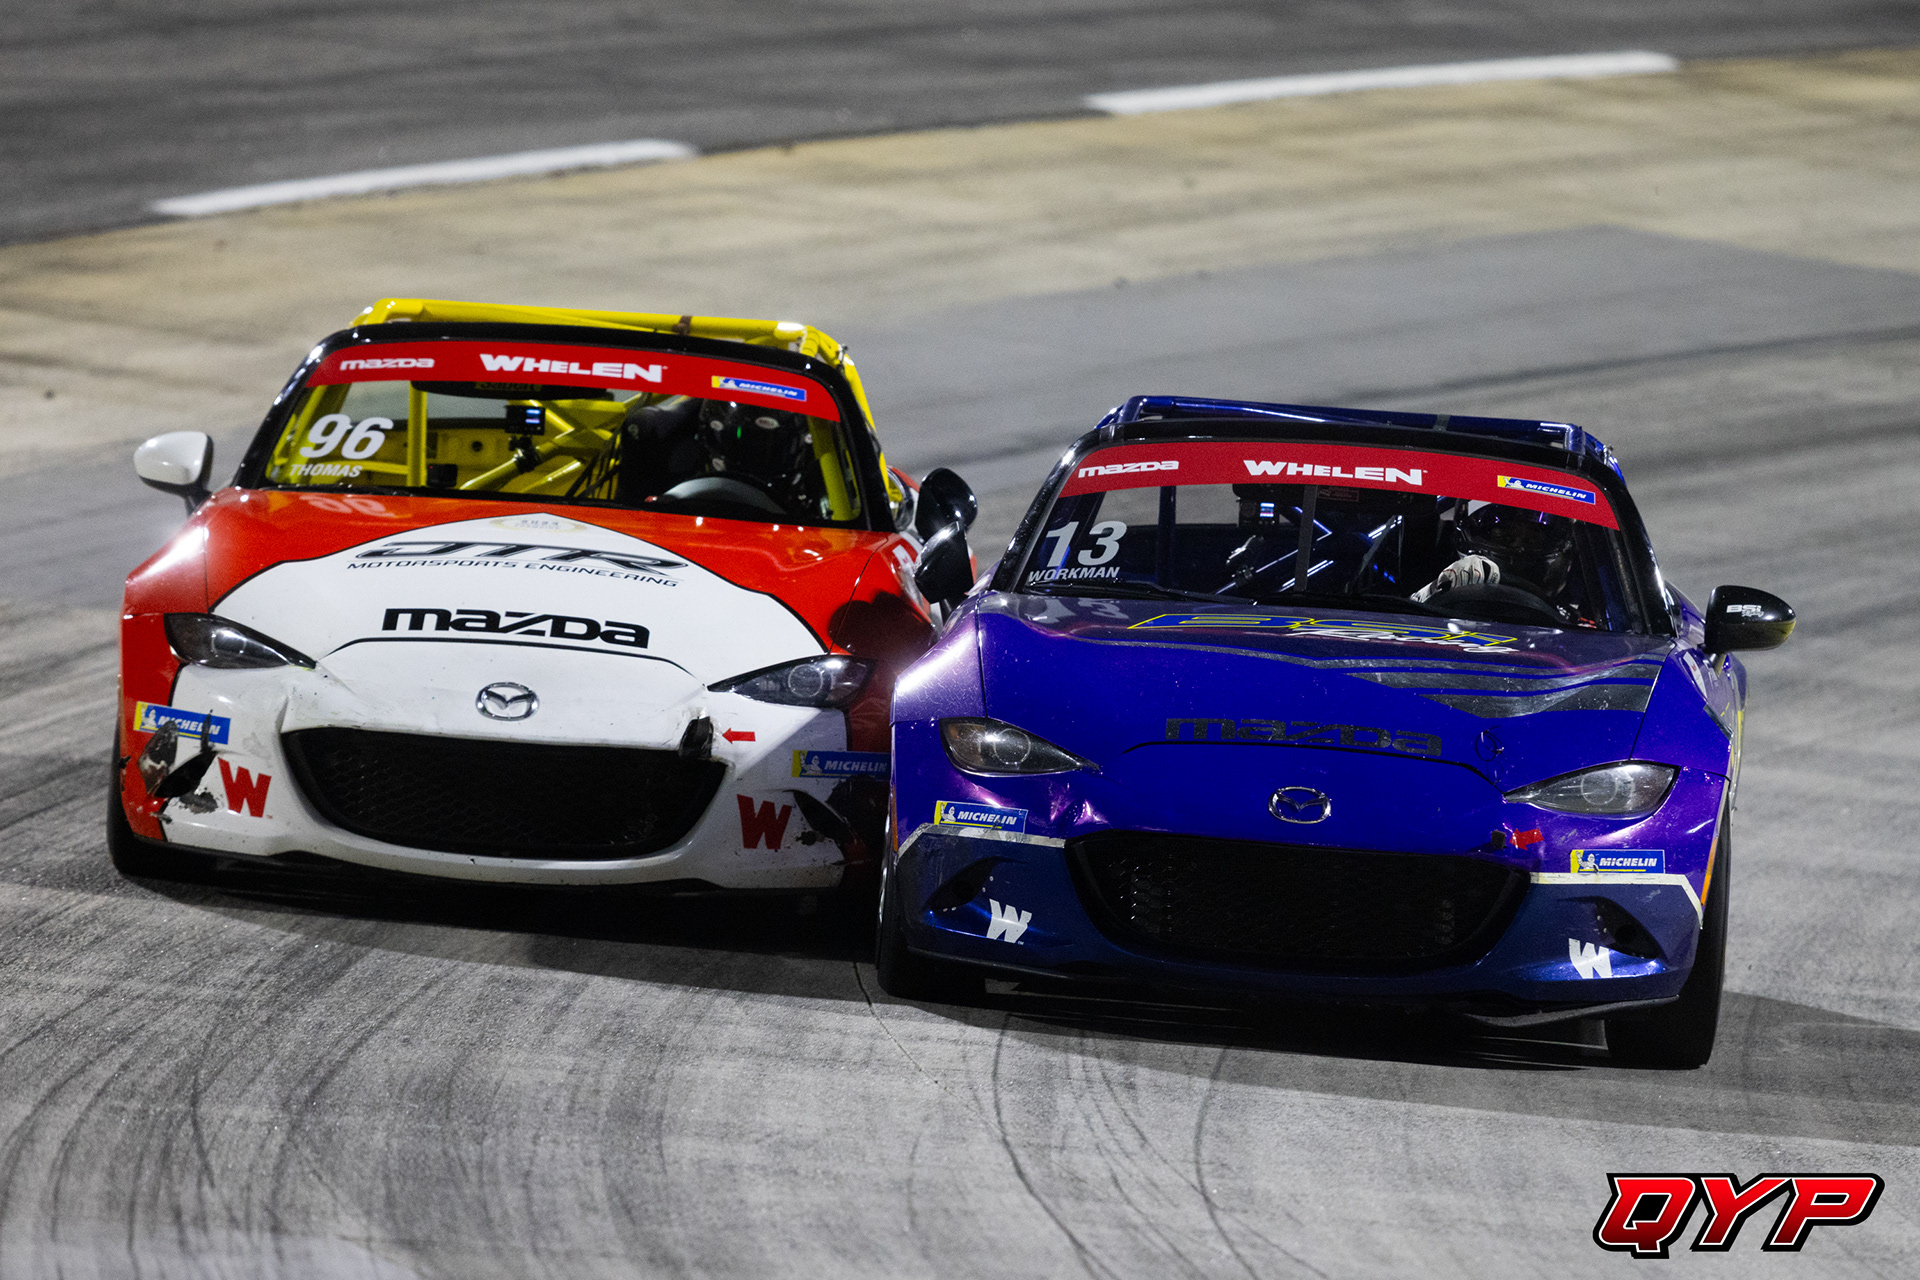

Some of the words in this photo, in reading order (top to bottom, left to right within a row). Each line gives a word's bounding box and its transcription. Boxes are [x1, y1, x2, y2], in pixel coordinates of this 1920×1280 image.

[479, 352, 664, 384] WHELEN
[740, 382, 799, 398] MICHELIN
[299, 413, 395, 461] 96
[289, 463, 363, 479] THOMAS
[1242, 459, 1424, 487] WHELEN
[1526, 482, 1588, 500] MICHELIN
[1043, 520, 1128, 567] 13
[347, 559, 518, 570] MOTORSPORTS
[525, 562, 679, 588] ENGINEERING
[1027, 565, 1120, 582] WORKMAN
[824, 760, 887, 773] MICHELIN
[217, 756, 272, 818] W
[736, 794, 792, 850] W
[957, 809, 1018, 826] MICHELIN
[1599, 855, 1658, 868] MICHELIN
[985, 898, 1033, 944] W
[1568, 938, 1613, 980] W
